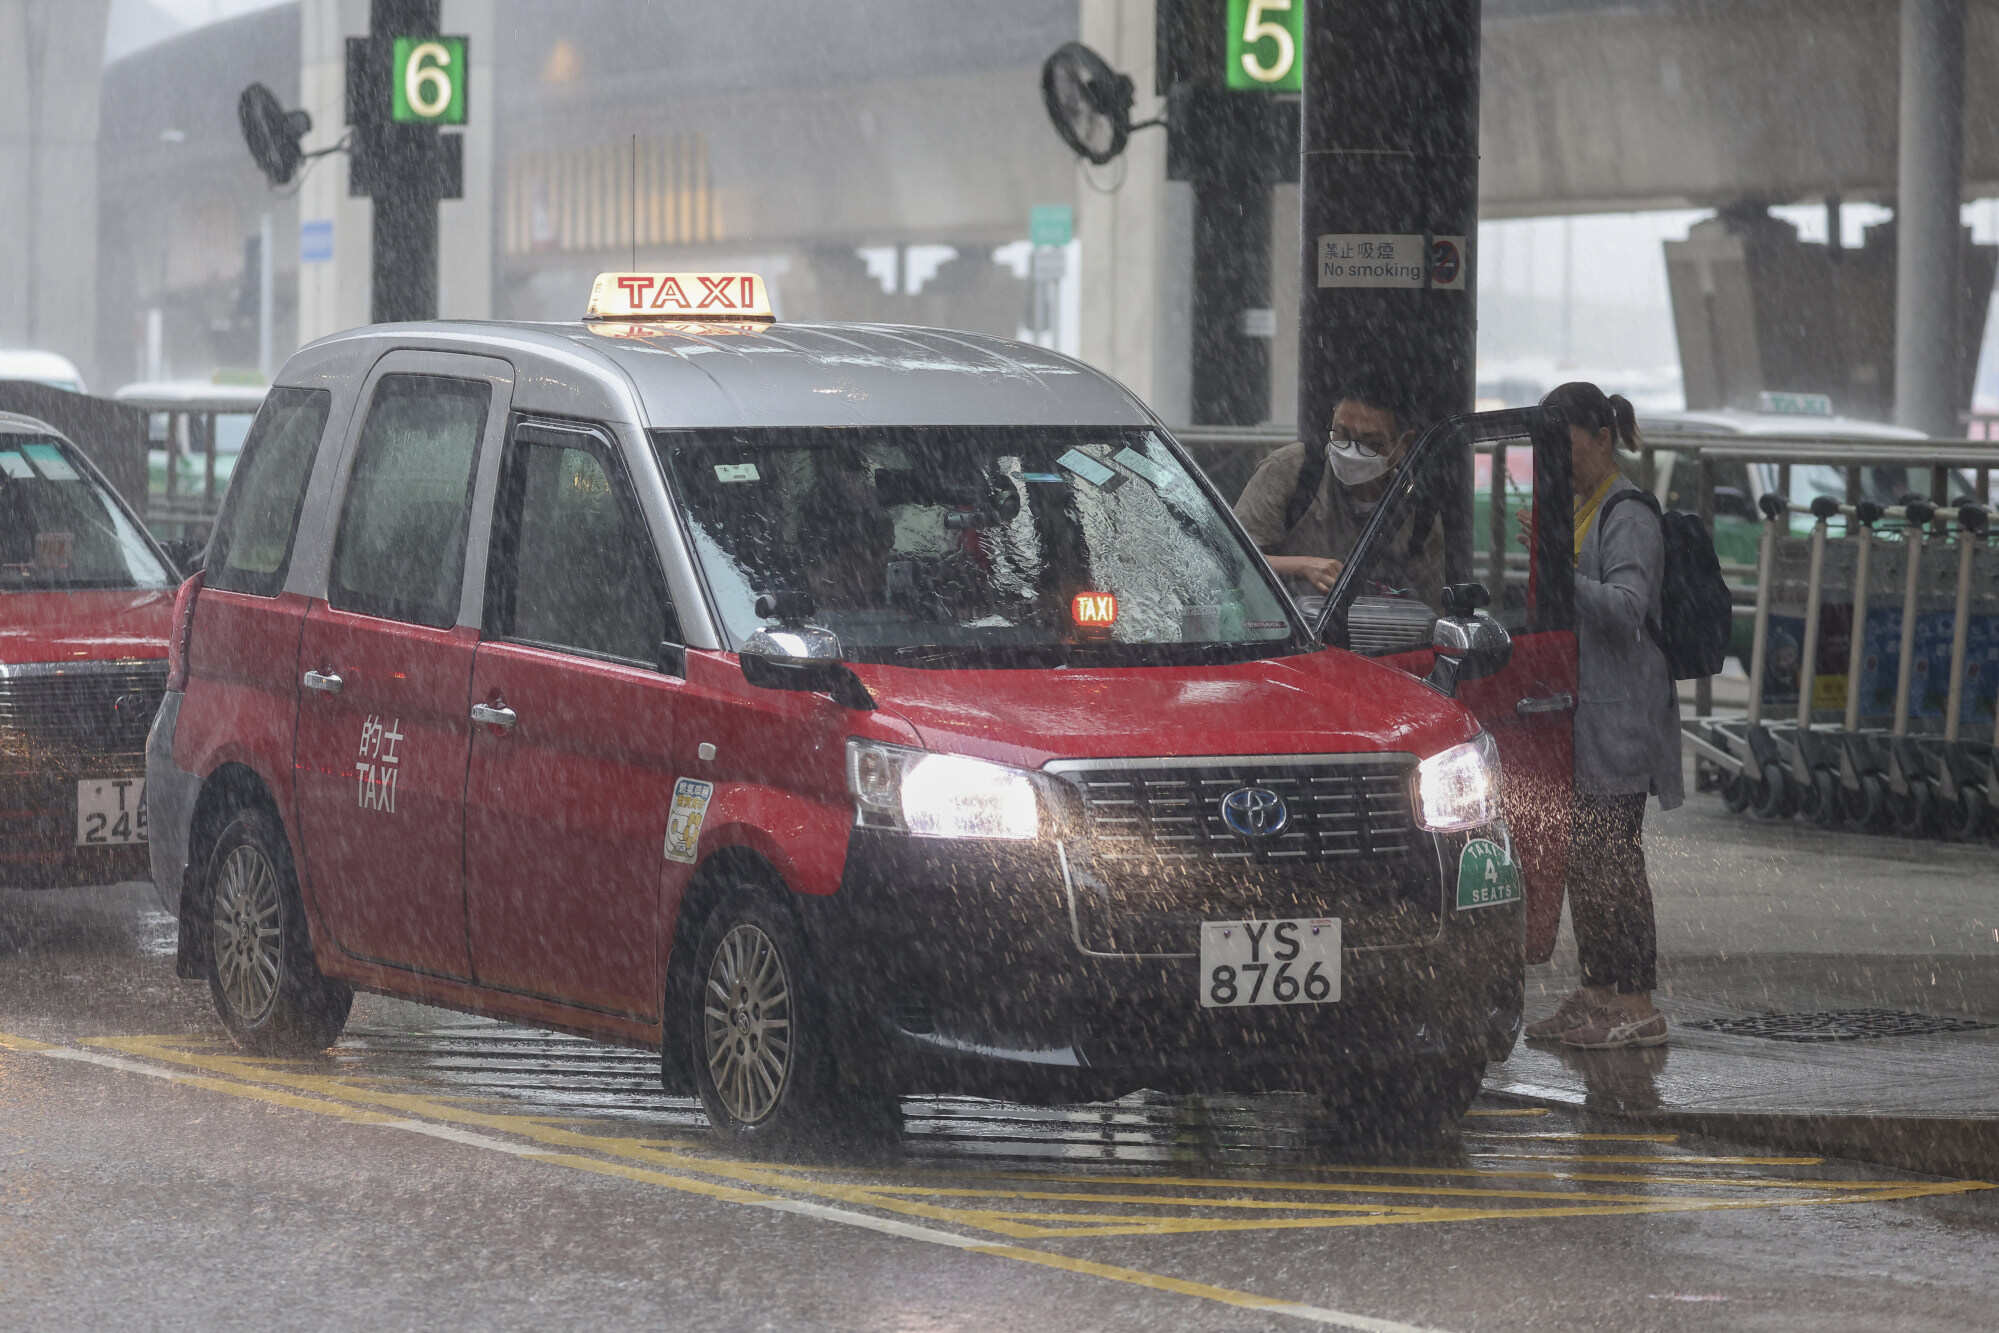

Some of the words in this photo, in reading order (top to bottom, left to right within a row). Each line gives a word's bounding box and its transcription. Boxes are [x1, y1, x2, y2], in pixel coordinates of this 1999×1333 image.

[1241, 0, 1294, 83] 5
[405, 43, 451, 117] 6
[1325, 242, 1395, 260] 禁止吸煙
[1324, 262, 1344, 277] No
[1348, 263, 1421, 280] smoking
[617, 277, 754, 309] TAXI
[1771, 395, 1825, 413] TAXI
[1076, 596, 1113, 622] TAXI
[359, 713, 404, 763] 的士
[355, 762, 397, 813] TAXI
[1467, 842, 1498, 859] TAXI
[1484, 858, 1499, 884] 4
[1472, 884, 1512, 903] SEATS
[1242, 921, 1301, 962] YS
[1210, 961, 1331, 1004] 8766
